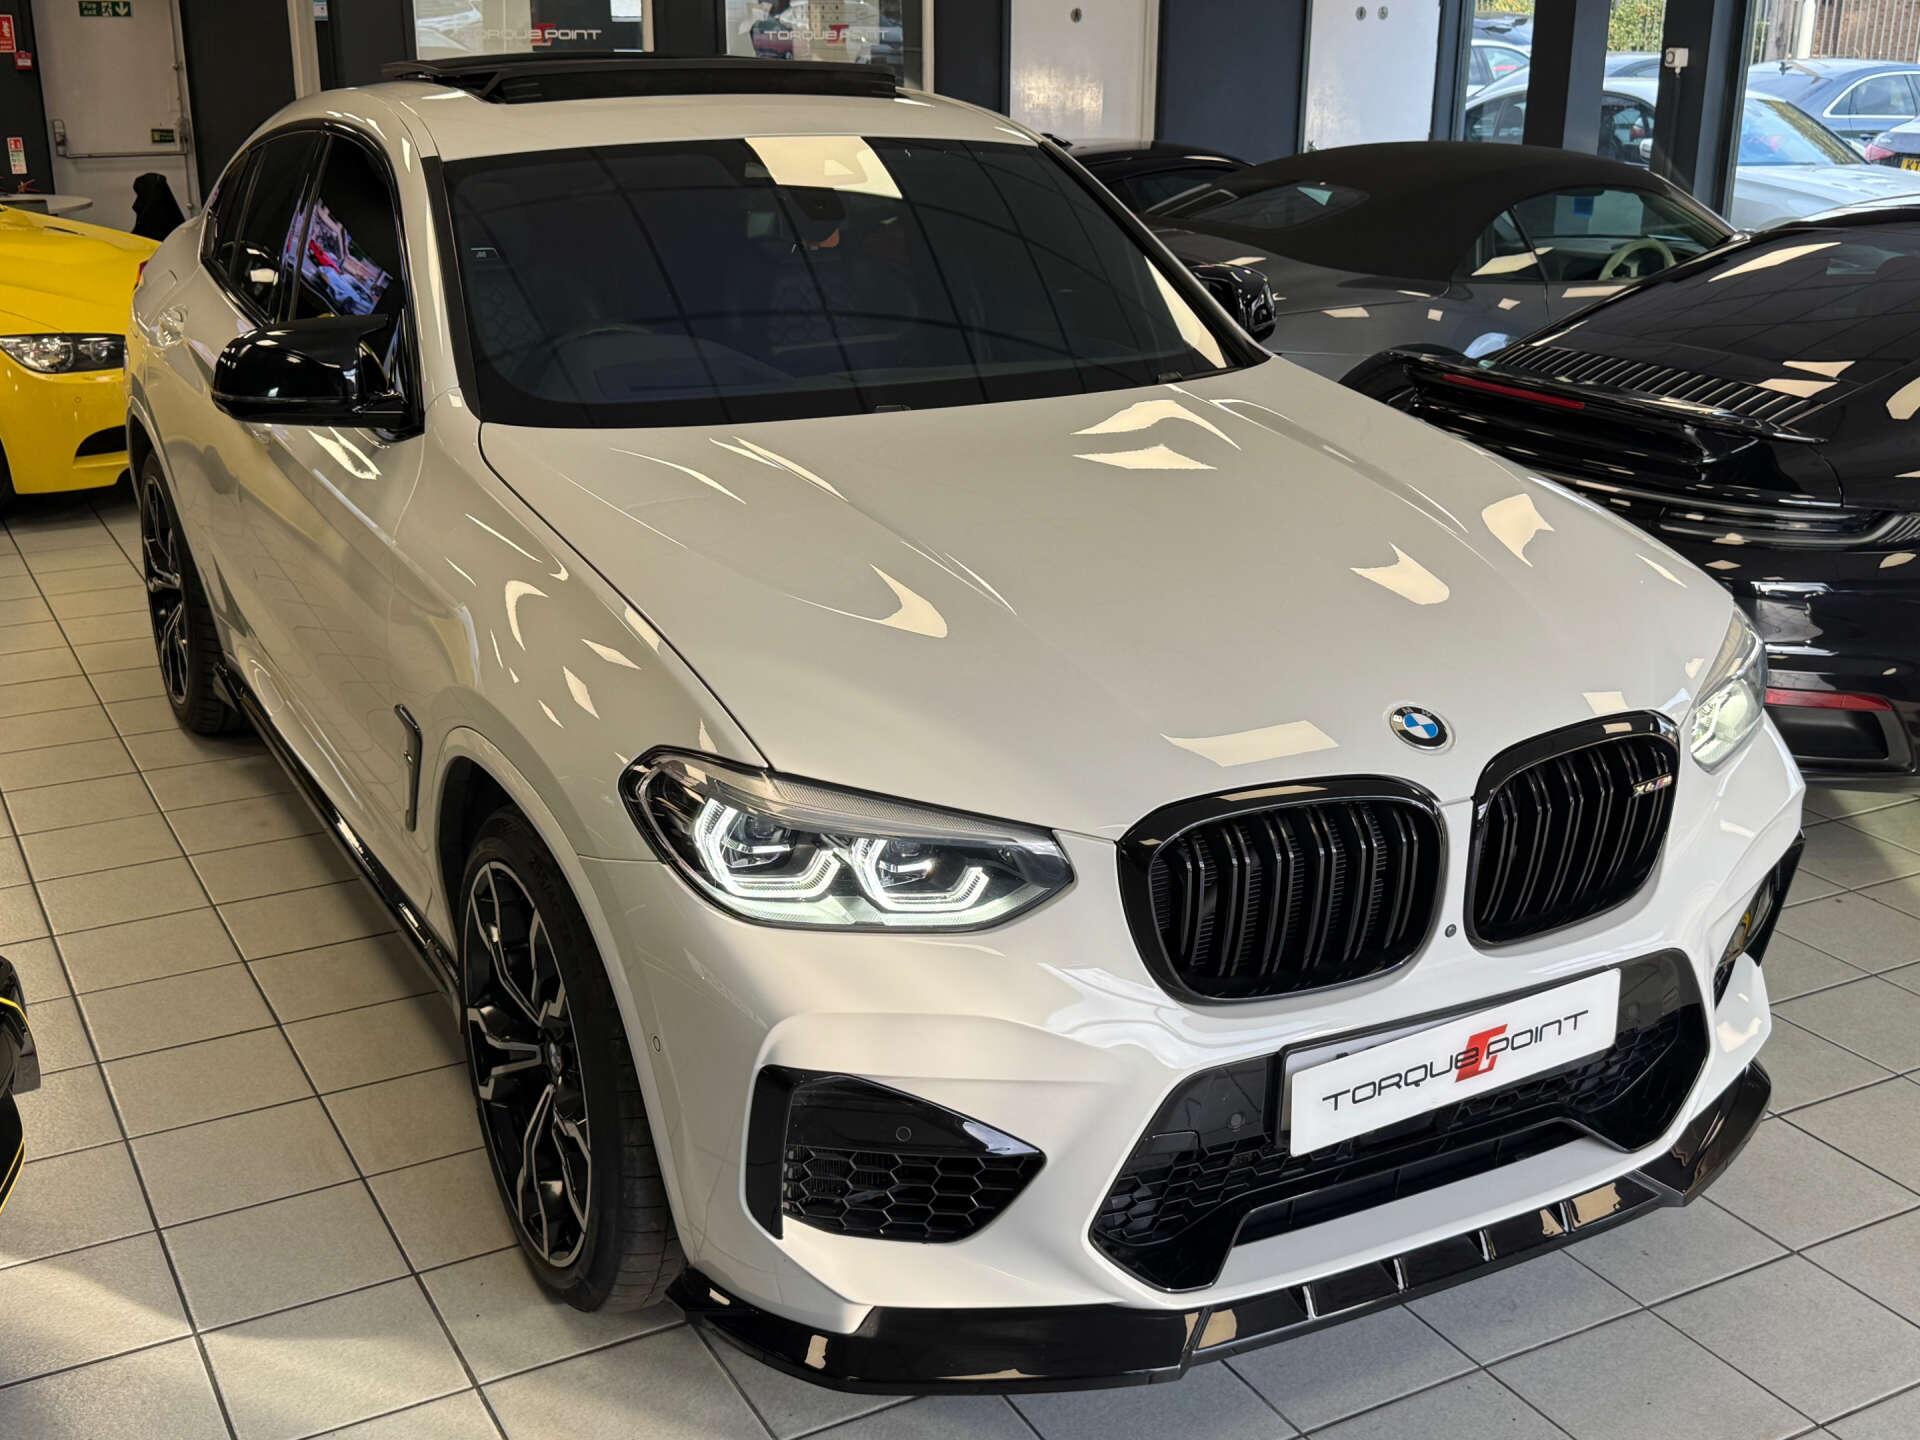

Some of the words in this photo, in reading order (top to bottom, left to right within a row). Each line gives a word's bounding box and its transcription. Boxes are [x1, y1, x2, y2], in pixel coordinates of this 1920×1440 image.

[544, 29, 602, 40] POINT
[1322, 1045, 1480, 1111] TORQUE
[1485, 1009, 1589, 1060] POINT
